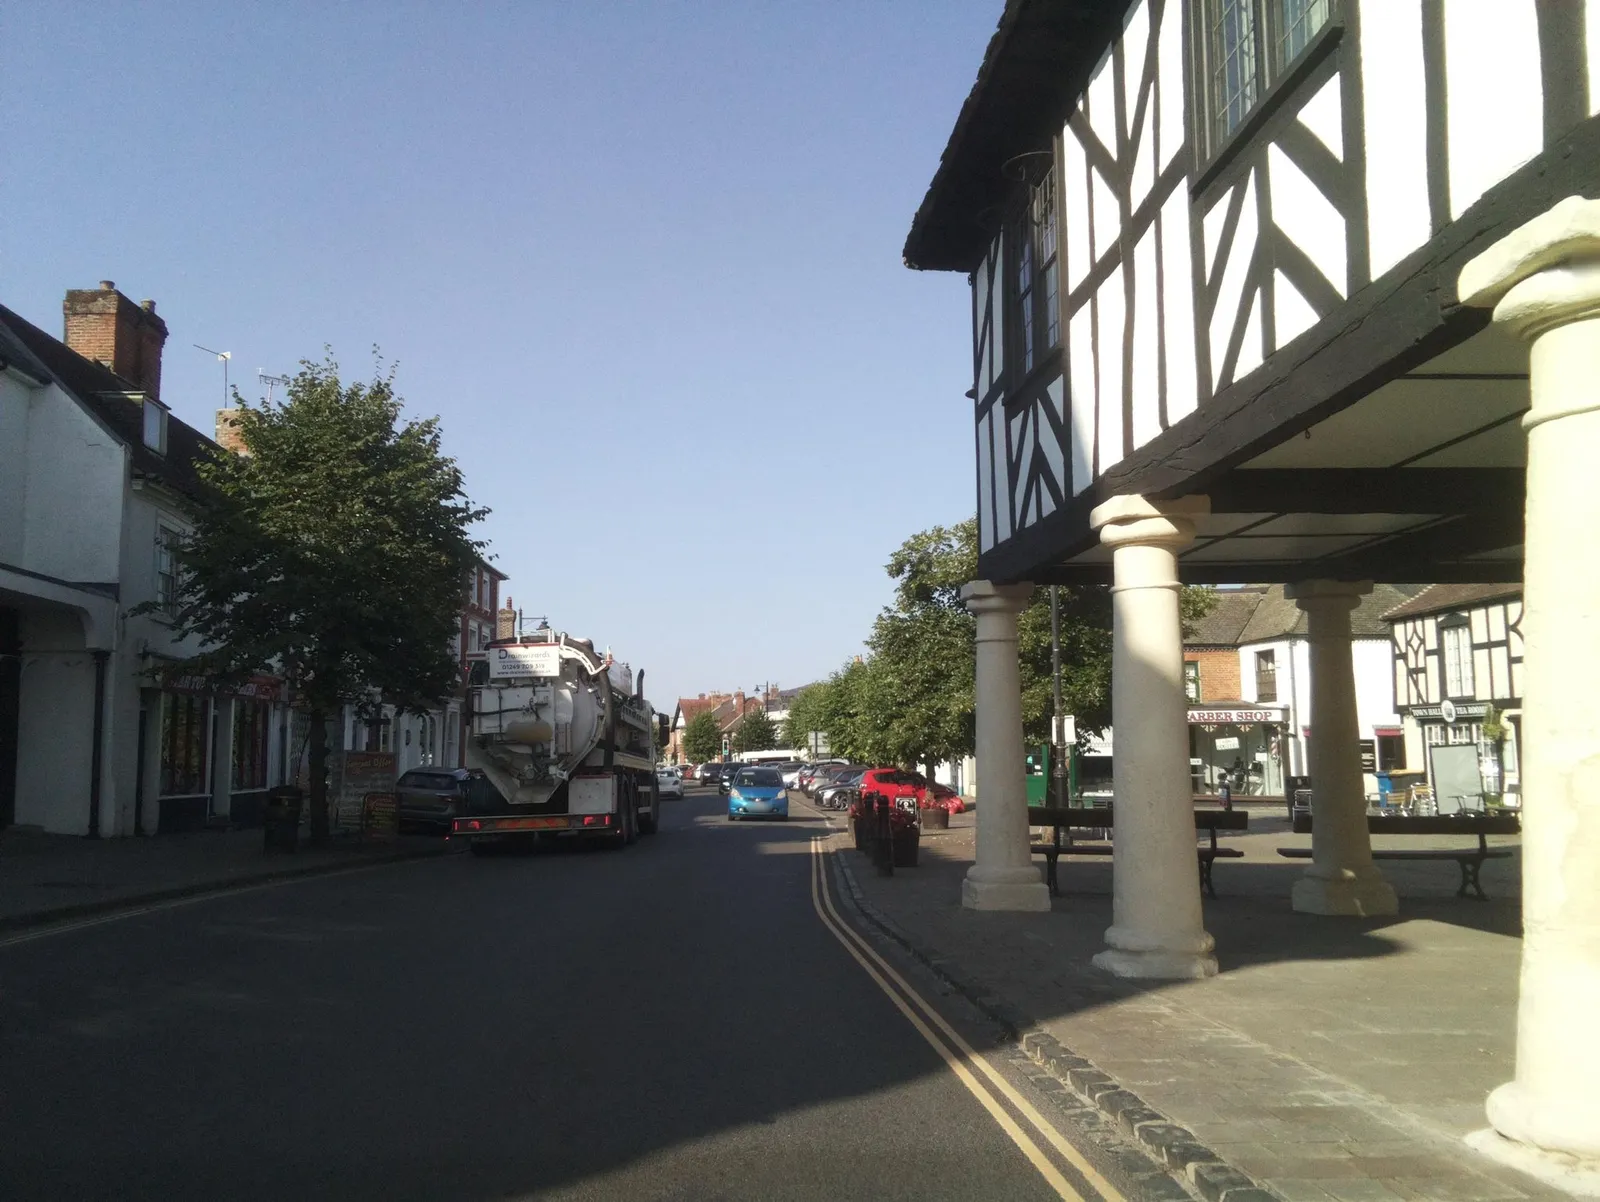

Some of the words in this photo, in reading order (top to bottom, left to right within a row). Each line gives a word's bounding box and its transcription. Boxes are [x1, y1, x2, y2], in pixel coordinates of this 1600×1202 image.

[498, 649, 550, 659] Drainwizards
[1412, 709, 1428, 717] TOWN
[1428, 708, 1443, 716] HALL
[1456, 707, 1467, 715] TEA
[1187, 711, 1233, 721] ARBER
[1236, 711, 1272, 721] SHOP
